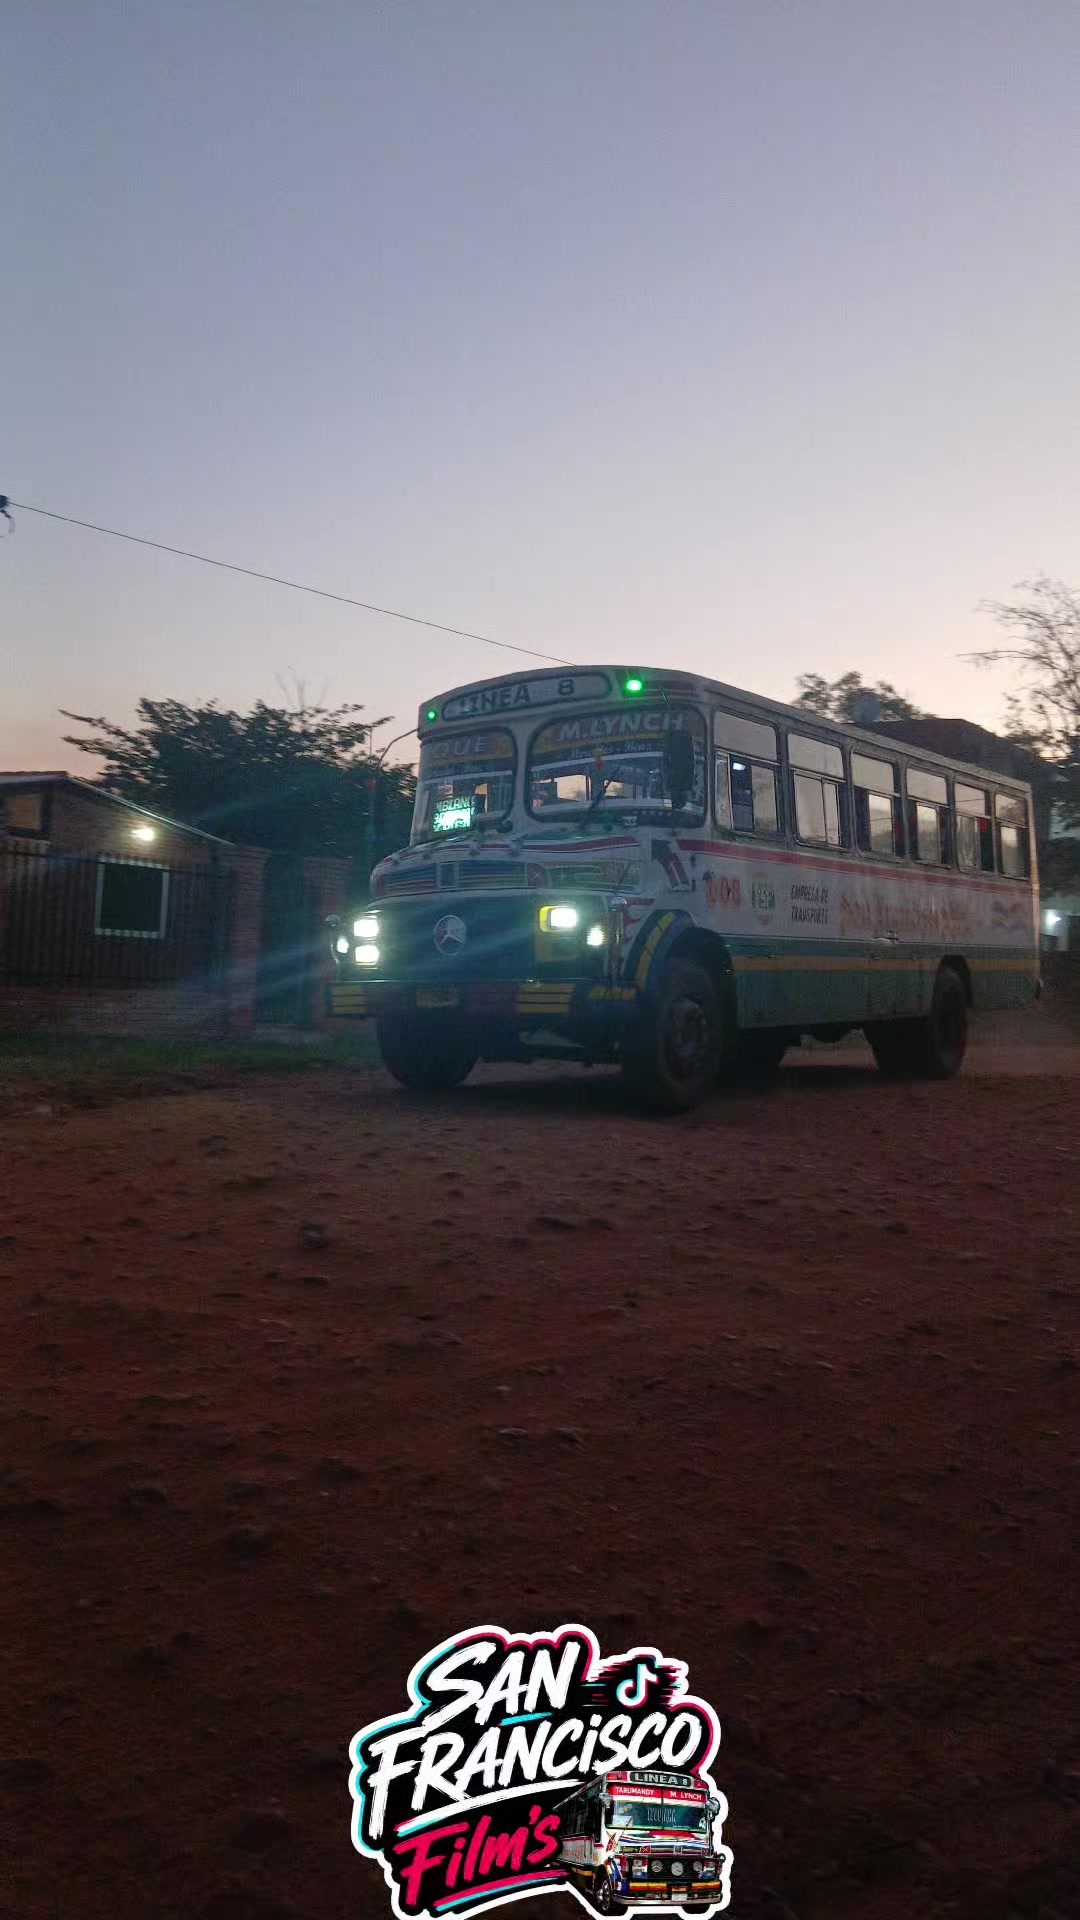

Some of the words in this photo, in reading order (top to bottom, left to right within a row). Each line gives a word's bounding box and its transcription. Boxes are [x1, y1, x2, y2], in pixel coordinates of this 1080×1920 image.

[459, 684, 531, 714] LINEA
[557, 679, 575, 696] 8
[790, 883, 819, 903] EMPRESA
[819, 888, 829, 904] DE
[790, 905, 829, 925] TRANSPORTE
